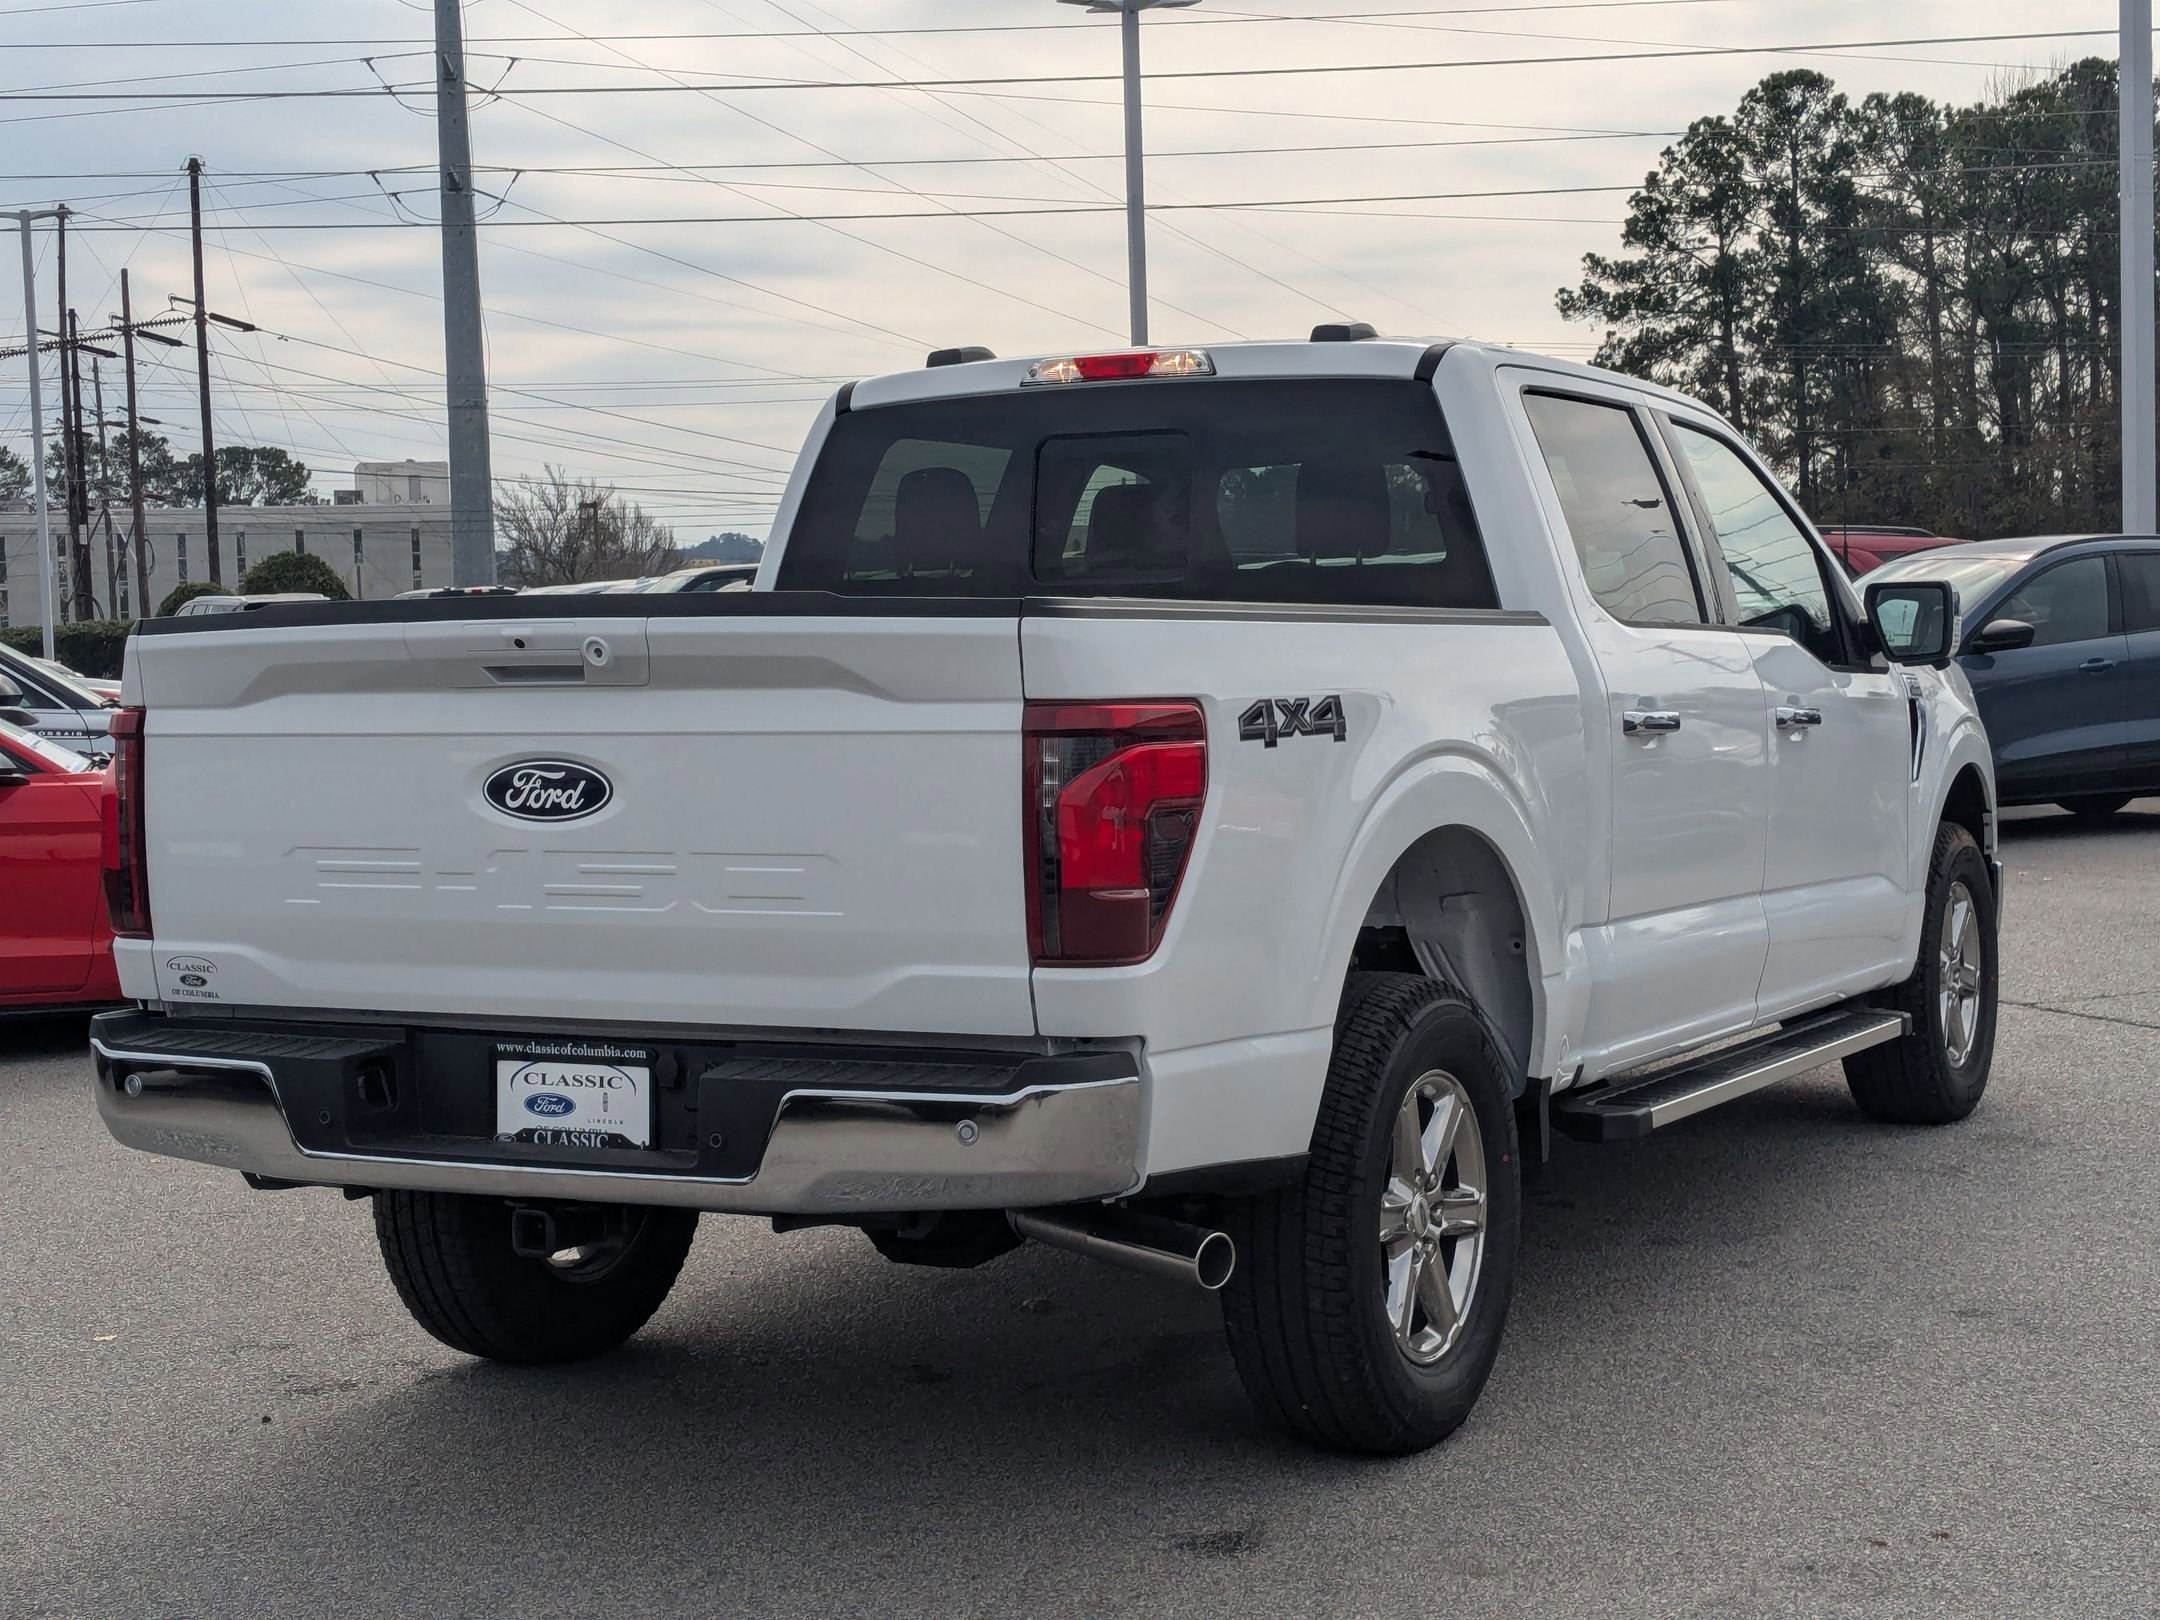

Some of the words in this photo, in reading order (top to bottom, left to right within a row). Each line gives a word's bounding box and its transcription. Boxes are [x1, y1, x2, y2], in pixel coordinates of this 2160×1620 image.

[505, 769, 587, 810] Ford
[170, 963, 214, 973] CLASSIC
[182, 989, 220, 998] COLUMBIA
[496, 1041, 647, 1059] www.classicofcolumbia.com
[523, 1071, 623, 1090] CLASSIC
[534, 1096, 566, 1113] Ford
[587, 1117, 624, 1125] LINCOLN
[533, 1130, 609, 1148] CLASSIC
